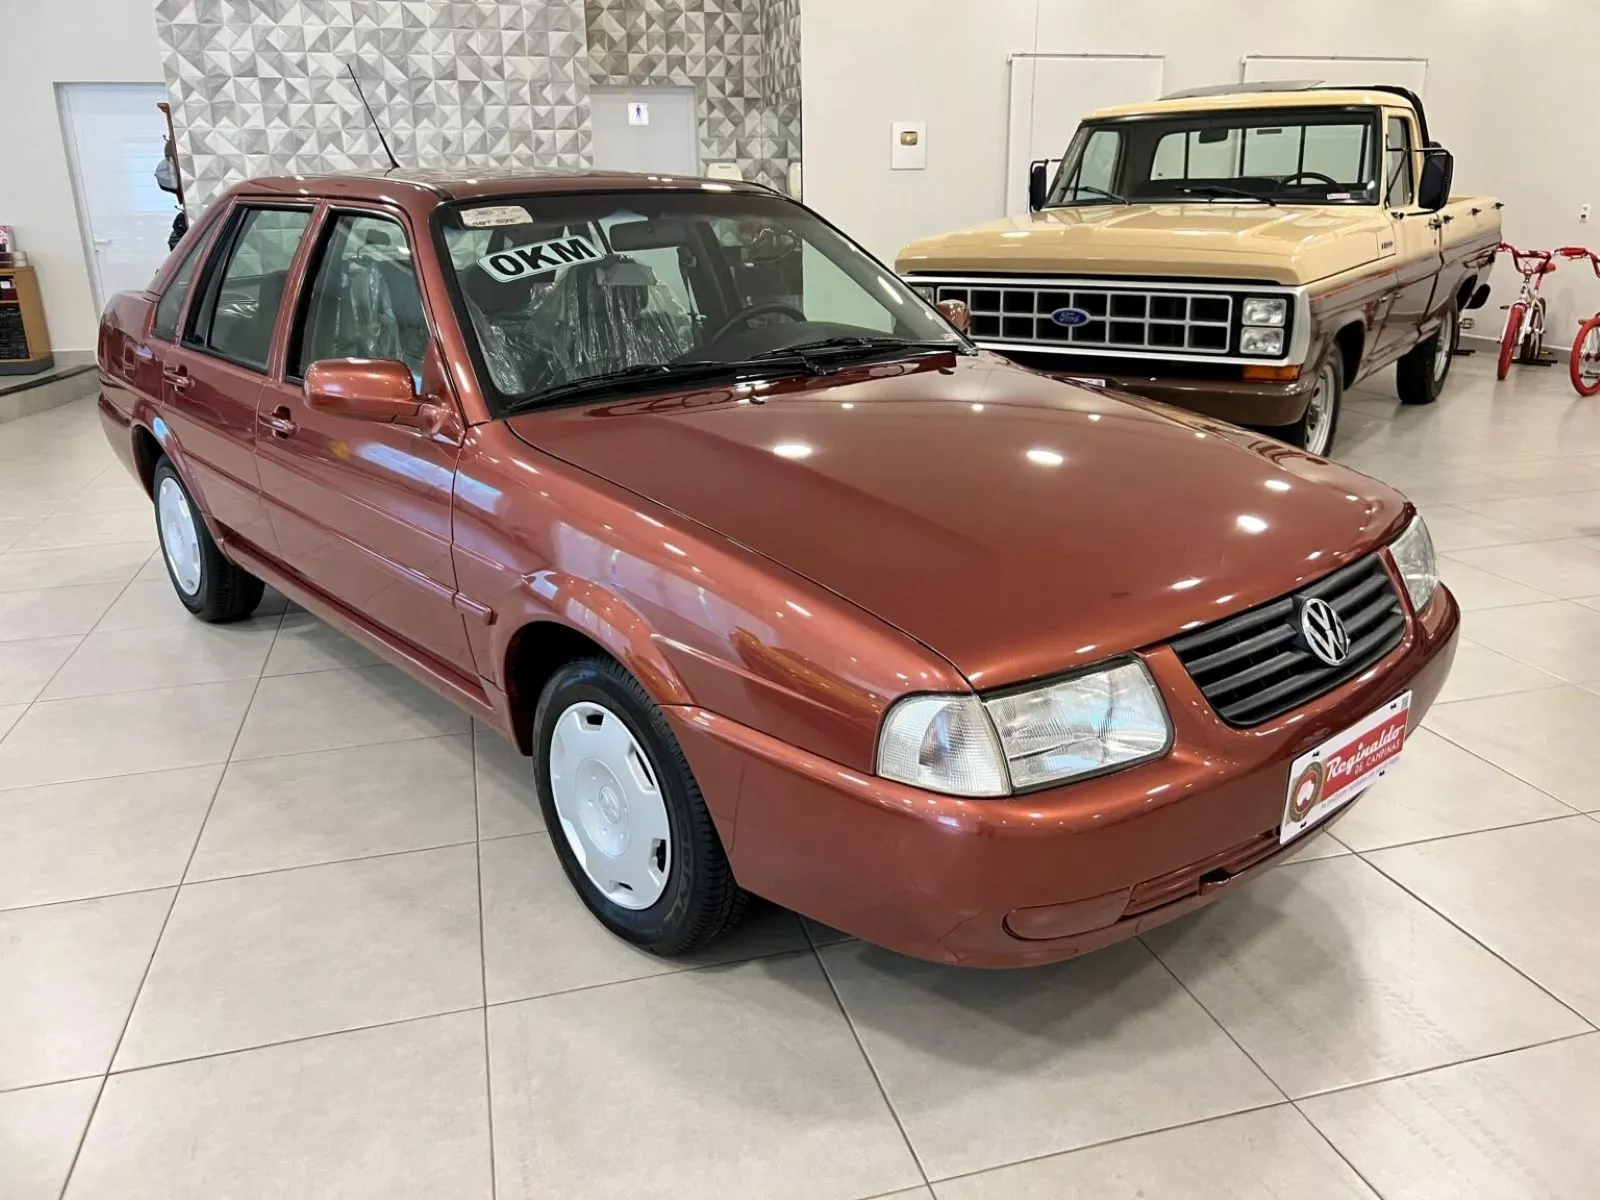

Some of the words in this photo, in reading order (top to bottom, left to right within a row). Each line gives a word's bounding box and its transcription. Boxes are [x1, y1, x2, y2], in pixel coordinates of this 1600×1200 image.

[1326, 724, 1405, 782] Reginaldo
[1354, 761, 1365, 775] DE
[1365, 738, 1400, 767] CAMPINAS
